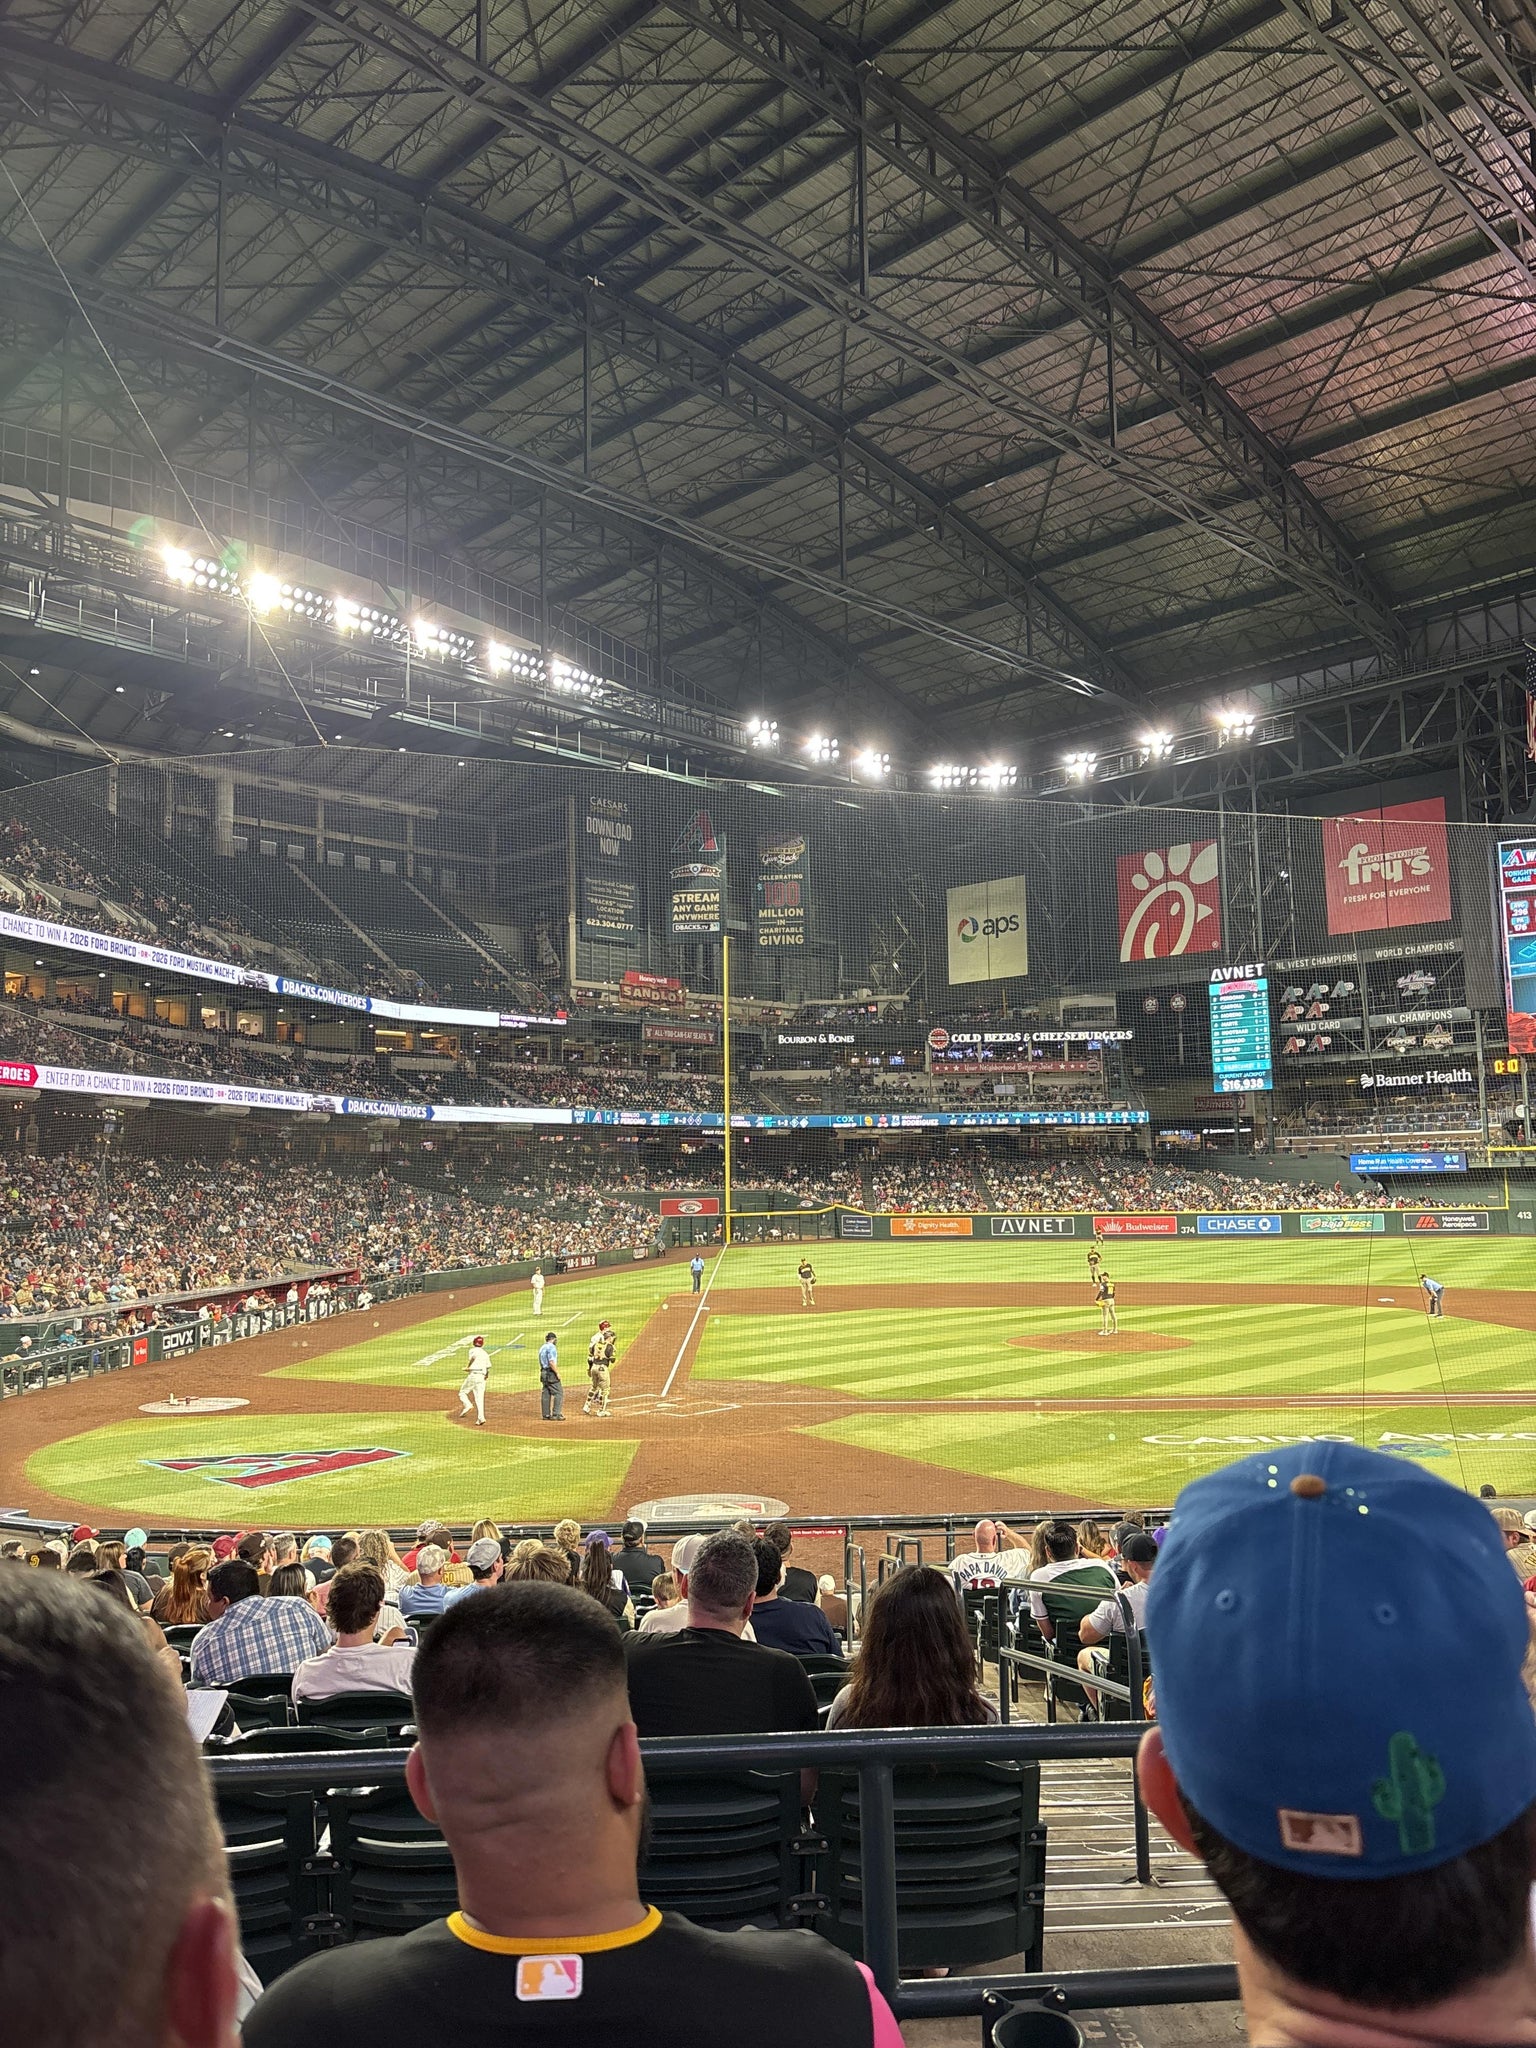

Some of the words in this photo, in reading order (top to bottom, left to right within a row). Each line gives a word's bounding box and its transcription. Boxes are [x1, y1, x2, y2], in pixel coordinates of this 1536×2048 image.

[590, 796, 628, 812] CAESARS
[586, 816, 632, 841] DOWNLOAD
[600, 837, 619, 856] NOW
[1361, 855, 1384, 864] FOOD
[1389, 848, 1425, 859] STORES
[1339, 843, 1431, 885] fry's
[672, 893, 720, 903] STREAM
[1344, 895, 1367, 904] FRESH
[1370, 891, 1386, 900] FOR
[1389, 884, 1431, 897] EVERYONE
[672, 904, 691, 912] ANY
[694, 904, 720, 912] GAME
[759, 908, 804, 918] MILLION
[672, 913, 720, 921] ANYWHERE
[586, 918, 634, 930] 623.304.0777
[982, 914, 1020, 938] aps
[760, 935, 804, 946] GIVING
[2, 917, 33, 935] CHANCE
[35, 923, 45, 938] TO
[47, 926, 61, 941] WIN
[63, 930, 68, 943] A
[70, 933, 89, 946] 2026
[91, 937, 108, 951] FORD
[110, 941, 137, 957] BRONCO
[152, 951, 168, 965] 2026
[170, 955, 185, 969] FORD
[187, 959, 213, 974] MUSTANG
[214, 965, 236, 980] MACH-E
[1375, 947, 1403, 959] WORLD
[1405, 941, 1455, 955] CHAMPIONS
[1276, 962, 1286, 970] NL
[1288, 958, 1309, 969] WEST
[1311, 953, 1358, 966] CHAMPIONS
[1211, 963, 1265, 982] AVNET
[639, 975, 668, 984] Honeywell
[282, 980, 367, 1010] DBACKS.COM/HEROES
[623, 986, 686, 1002] SANDLOT
[1386, 1015, 1397, 1024] NL
[1400, 1010, 1453, 1023] CHAMPIONS
[1296, 1022, 1317, 1032] WILD
[1318, 1020, 1341, 1031] CARD
[818, 1033, 827, 1043] &
[951, 1033, 981, 1042] COLD
[984, 1032, 1021, 1042] BEERS
[1023, 1033, 1031, 1042] &
[1032, 1030, 1133, 1041] CHEESEBURGERS
[979, 1062, 1016, 1071] Neighborhood
[1017, 1062, 1038, 1071] Burger
[1375, 1074, 1423, 1087] Banner
[1426, 1068, 1472, 1083] Health
[46, 1070, 69, 1086] ENTER
[71, 1073, 85, 1087] FOR
[87, 1075, 92, 1088] A
[94, 1075, 120, 1091] CHANCE
[122, 1078, 131, 1092] TO
[132, 1080, 145, 1093] WIN
[153, 1082, 171, 1095] 2026
[172, 1083, 189, 1096] FORD
[190, 1085, 214, 1099] BRONCO
[228, 1089, 243, 1101] 2026
[244, 1090, 259, 1103] FORD
[260, 1092, 284, 1105] MUSTANG
[285, 1095, 305, 1107] MACH-E
[1222, 1078, 1264, 1091] $16,938
[347, 1100, 427, 1119] DBACKS.COM/HEROES
[836, 1115, 854, 1123] COX
[1442, 1215, 1475, 1223] Honeywell
[1517, 1211, 1532, 1219] 413
[917, 1222, 938, 1230] Dignity
[1000, 1219, 1066, 1233] AVNET
[1125, 1222, 1170, 1232] Budweiser
[1180, 1226, 1195, 1234] 374
[1207, 1219, 1256, 1230] CHASE
[581, 1256, 596, 1266] BAR-S
[162, 1329, 194, 1350] GOVX
[1141, 1434, 1355, 1445] CASINO
[960, 1562, 981, 1581] PAPA
[984, 1562, 1008, 1580] DAVID
